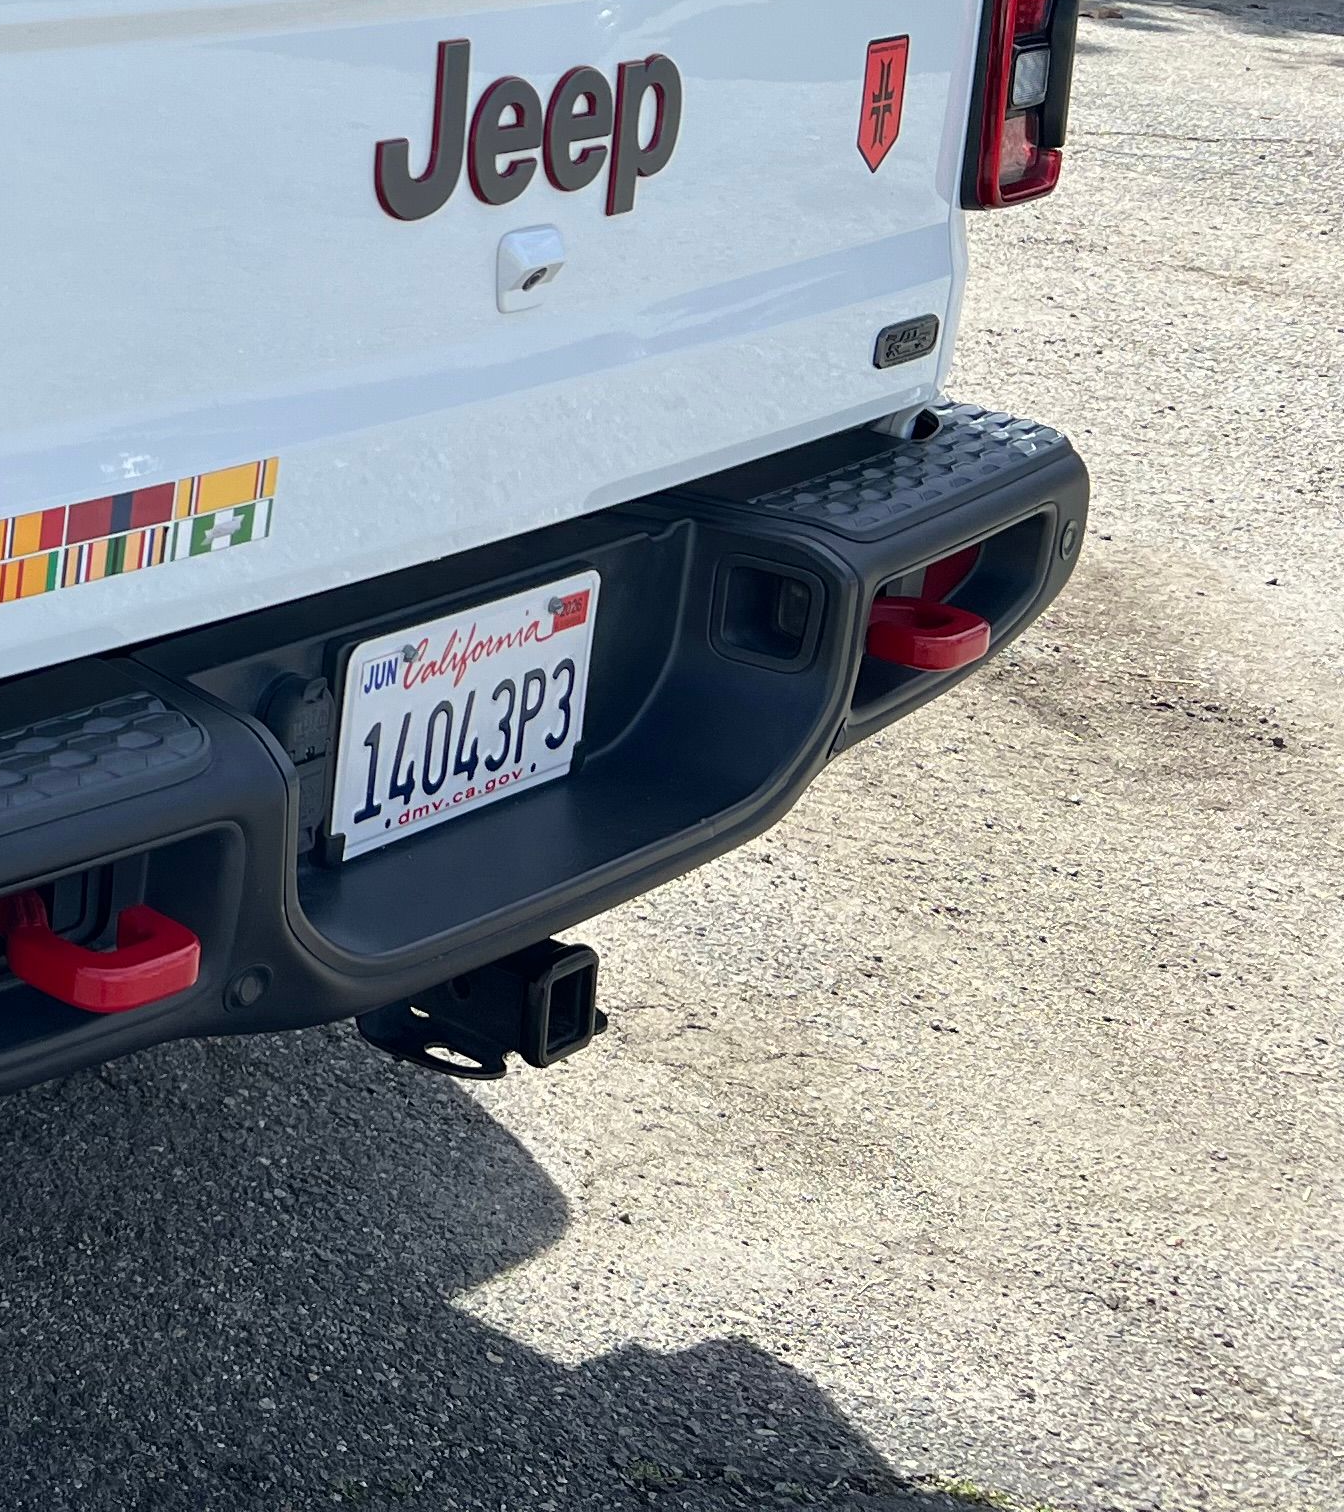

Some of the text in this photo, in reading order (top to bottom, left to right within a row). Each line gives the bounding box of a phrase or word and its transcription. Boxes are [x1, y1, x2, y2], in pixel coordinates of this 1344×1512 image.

[374, 37, 683, 222] Jeep
[363, 610, 555, 694] JUN California
[353, 657, 576, 825] 14043P3
[398, 767, 523, 826] dmv.ca.gov
